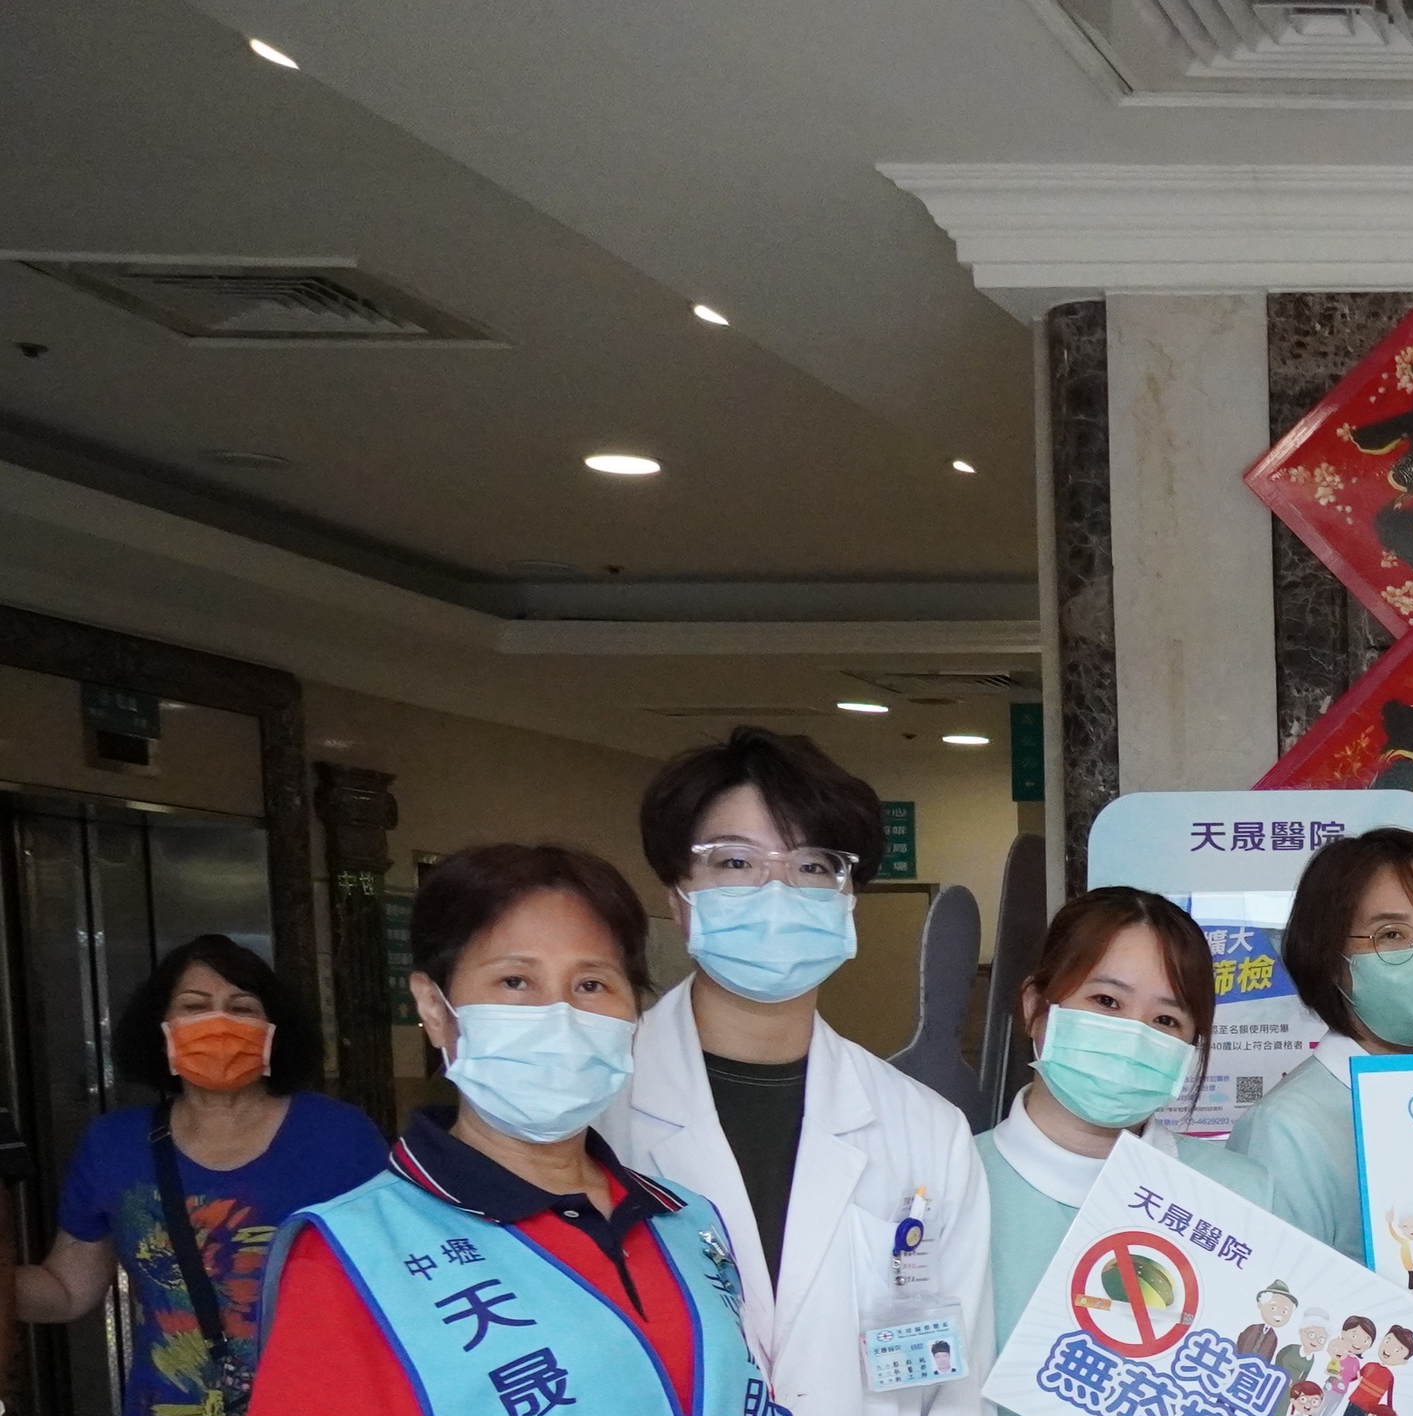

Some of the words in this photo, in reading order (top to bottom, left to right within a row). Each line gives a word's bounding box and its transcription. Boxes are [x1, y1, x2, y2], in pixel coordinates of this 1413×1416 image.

[1190, 821, 1346, 852] 天晟醫院
[1127, 1185, 1254, 1270] 天晟醫院
[404, 1238, 486, 1282] 中壢
